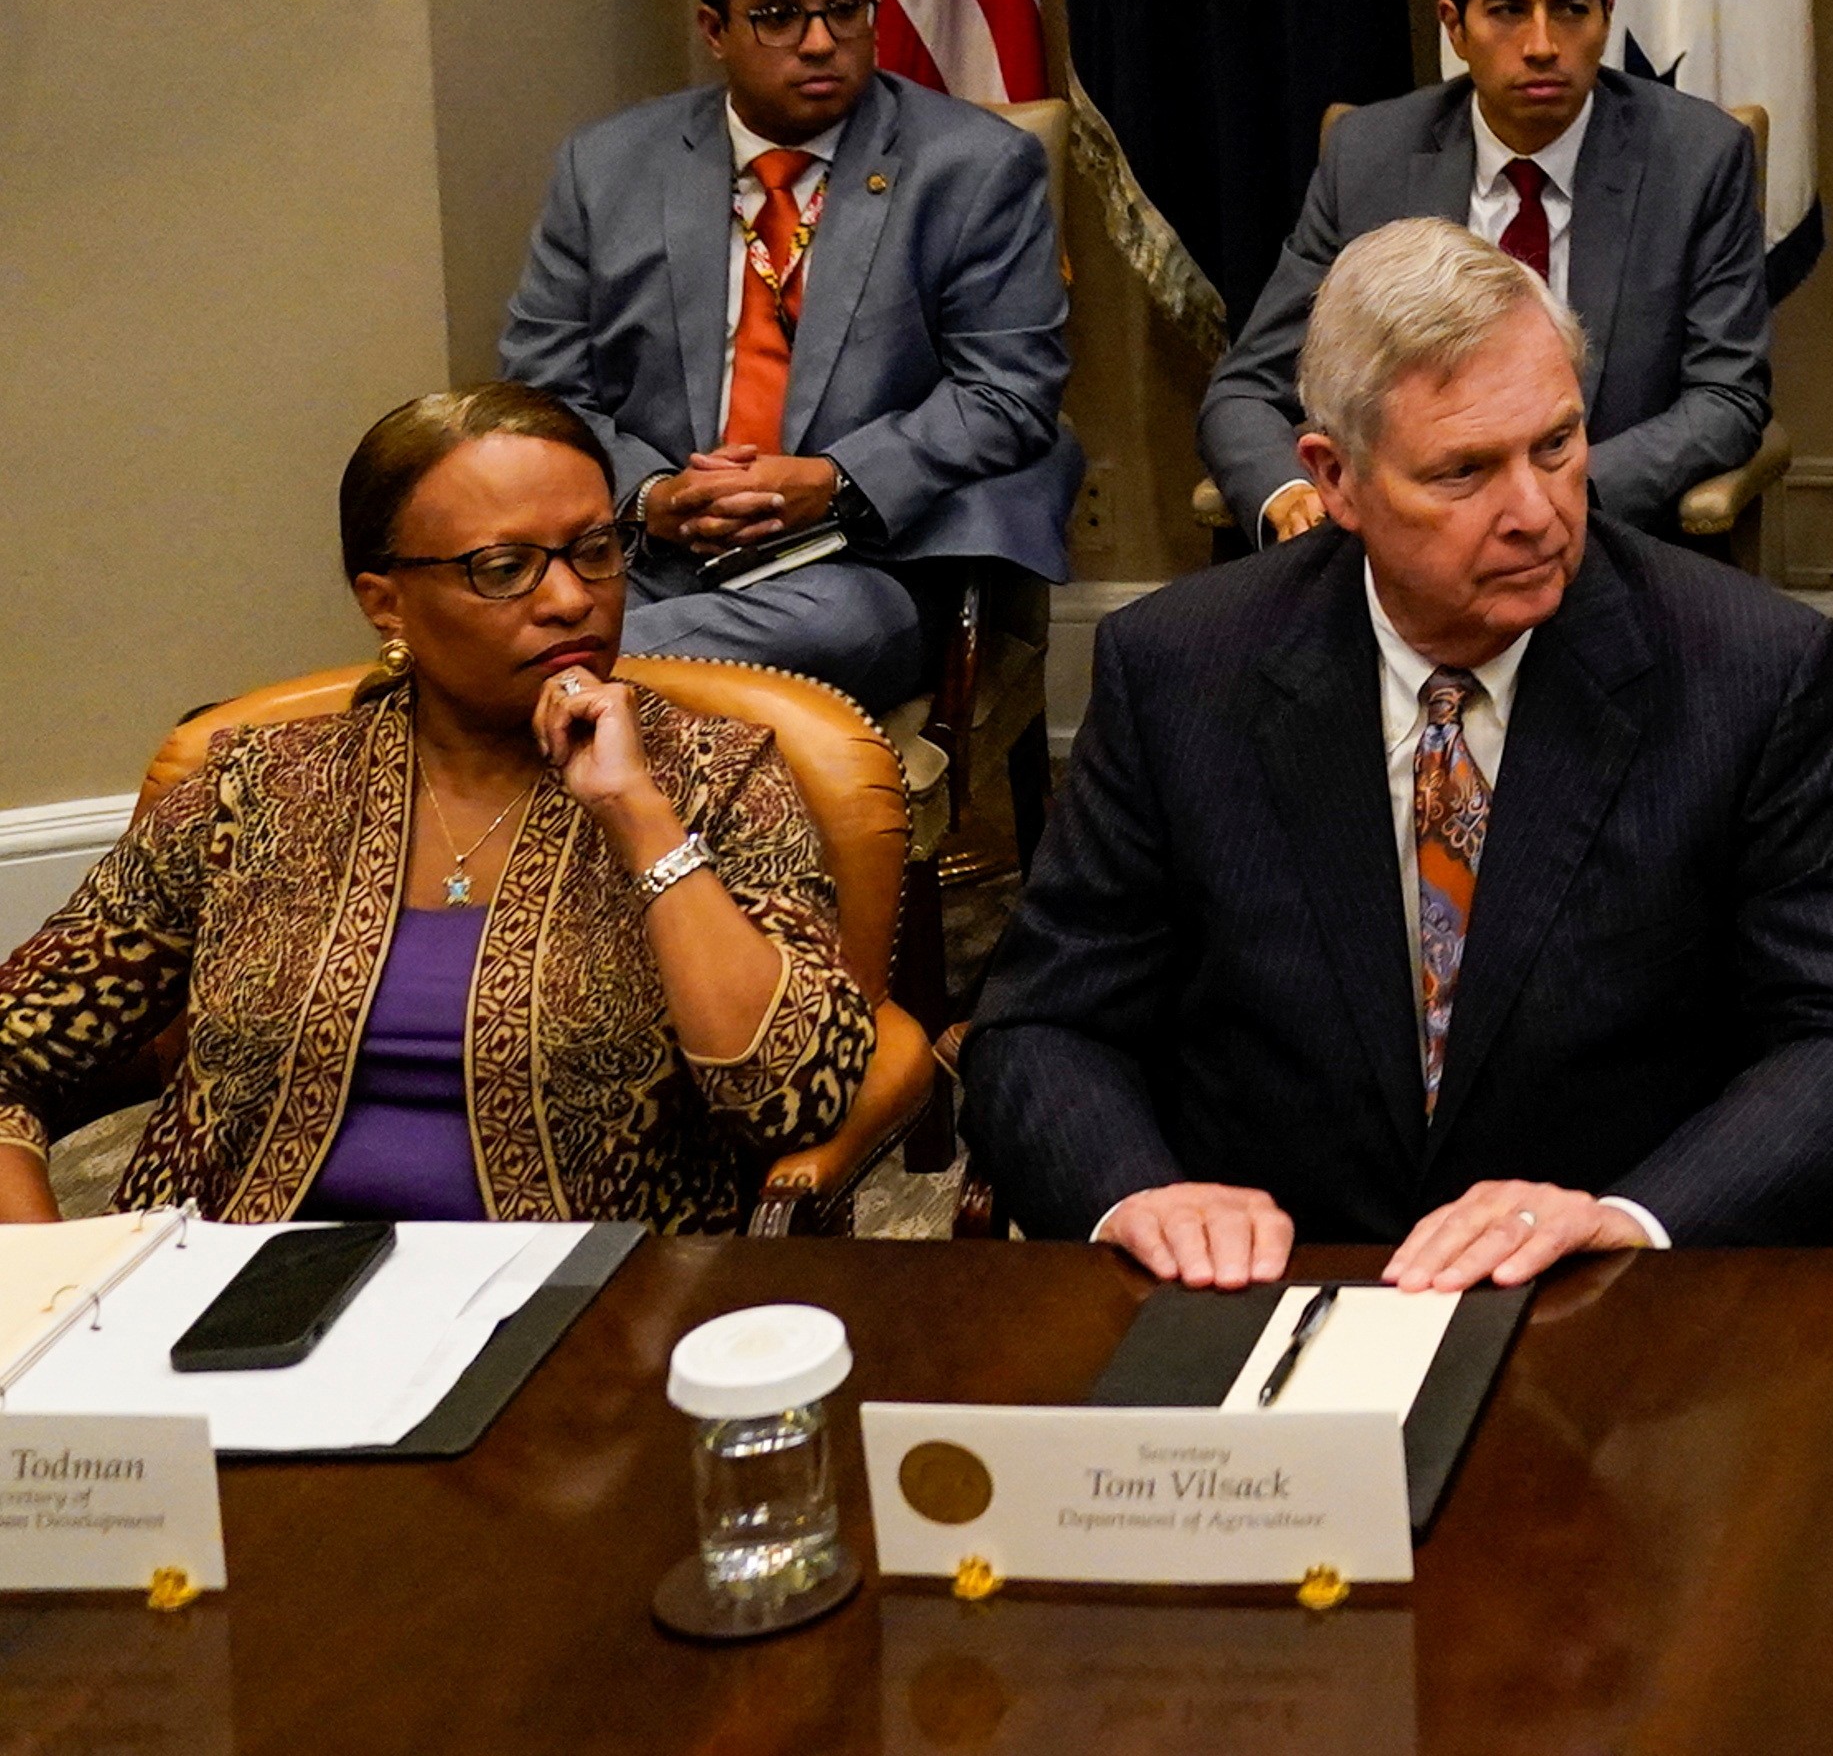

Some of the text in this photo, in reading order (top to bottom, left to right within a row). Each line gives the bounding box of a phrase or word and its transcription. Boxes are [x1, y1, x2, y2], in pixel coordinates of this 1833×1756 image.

[11, 1447, 145, 1481] Todman
[1137, 1444, 1231, 1465] Secretary
[1086, 1466, 1292, 1500] Tom Vilsack
[1057, 1507, 1176, 1531] Department
[1207, 1510, 1326, 1534] Agriculture
